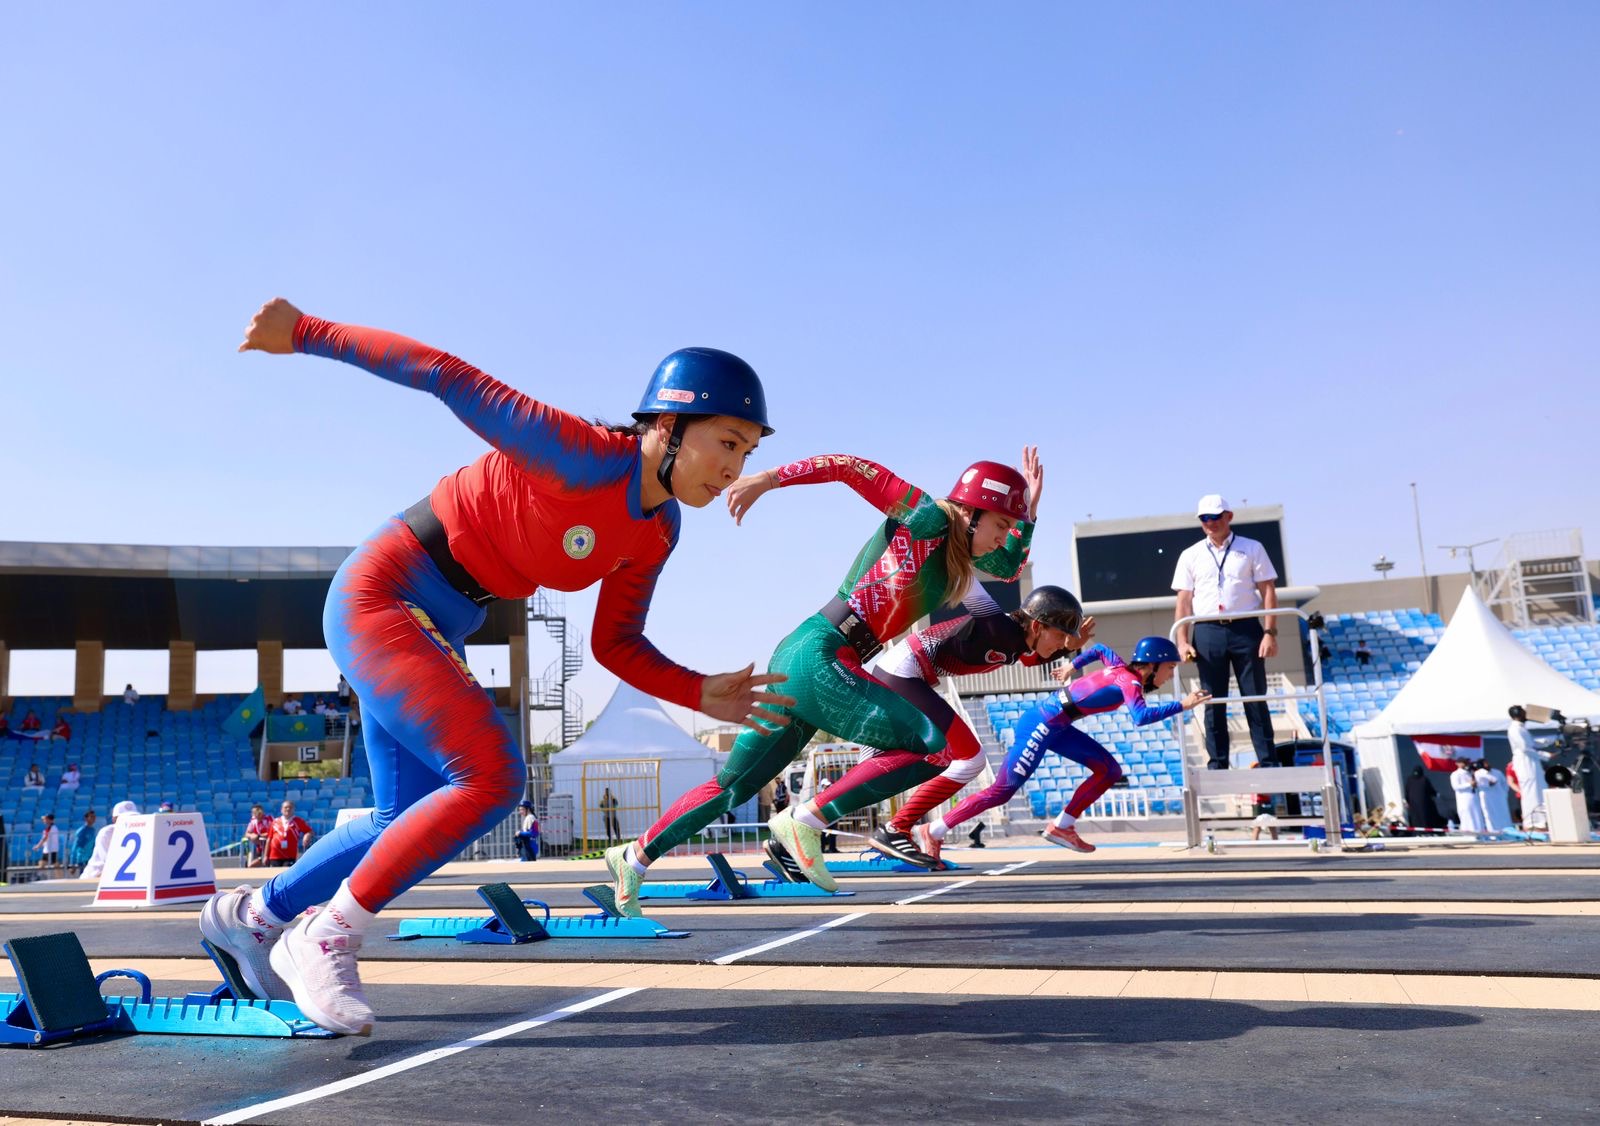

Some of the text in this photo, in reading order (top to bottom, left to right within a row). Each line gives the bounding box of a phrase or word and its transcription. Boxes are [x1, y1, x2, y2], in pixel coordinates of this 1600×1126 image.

[301, 747, 316, 760] 15
[1013, 722, 1050, 777] RUSSIA
[114, 831, 142, 881] 2
[168, 830, 197, 879] 2
